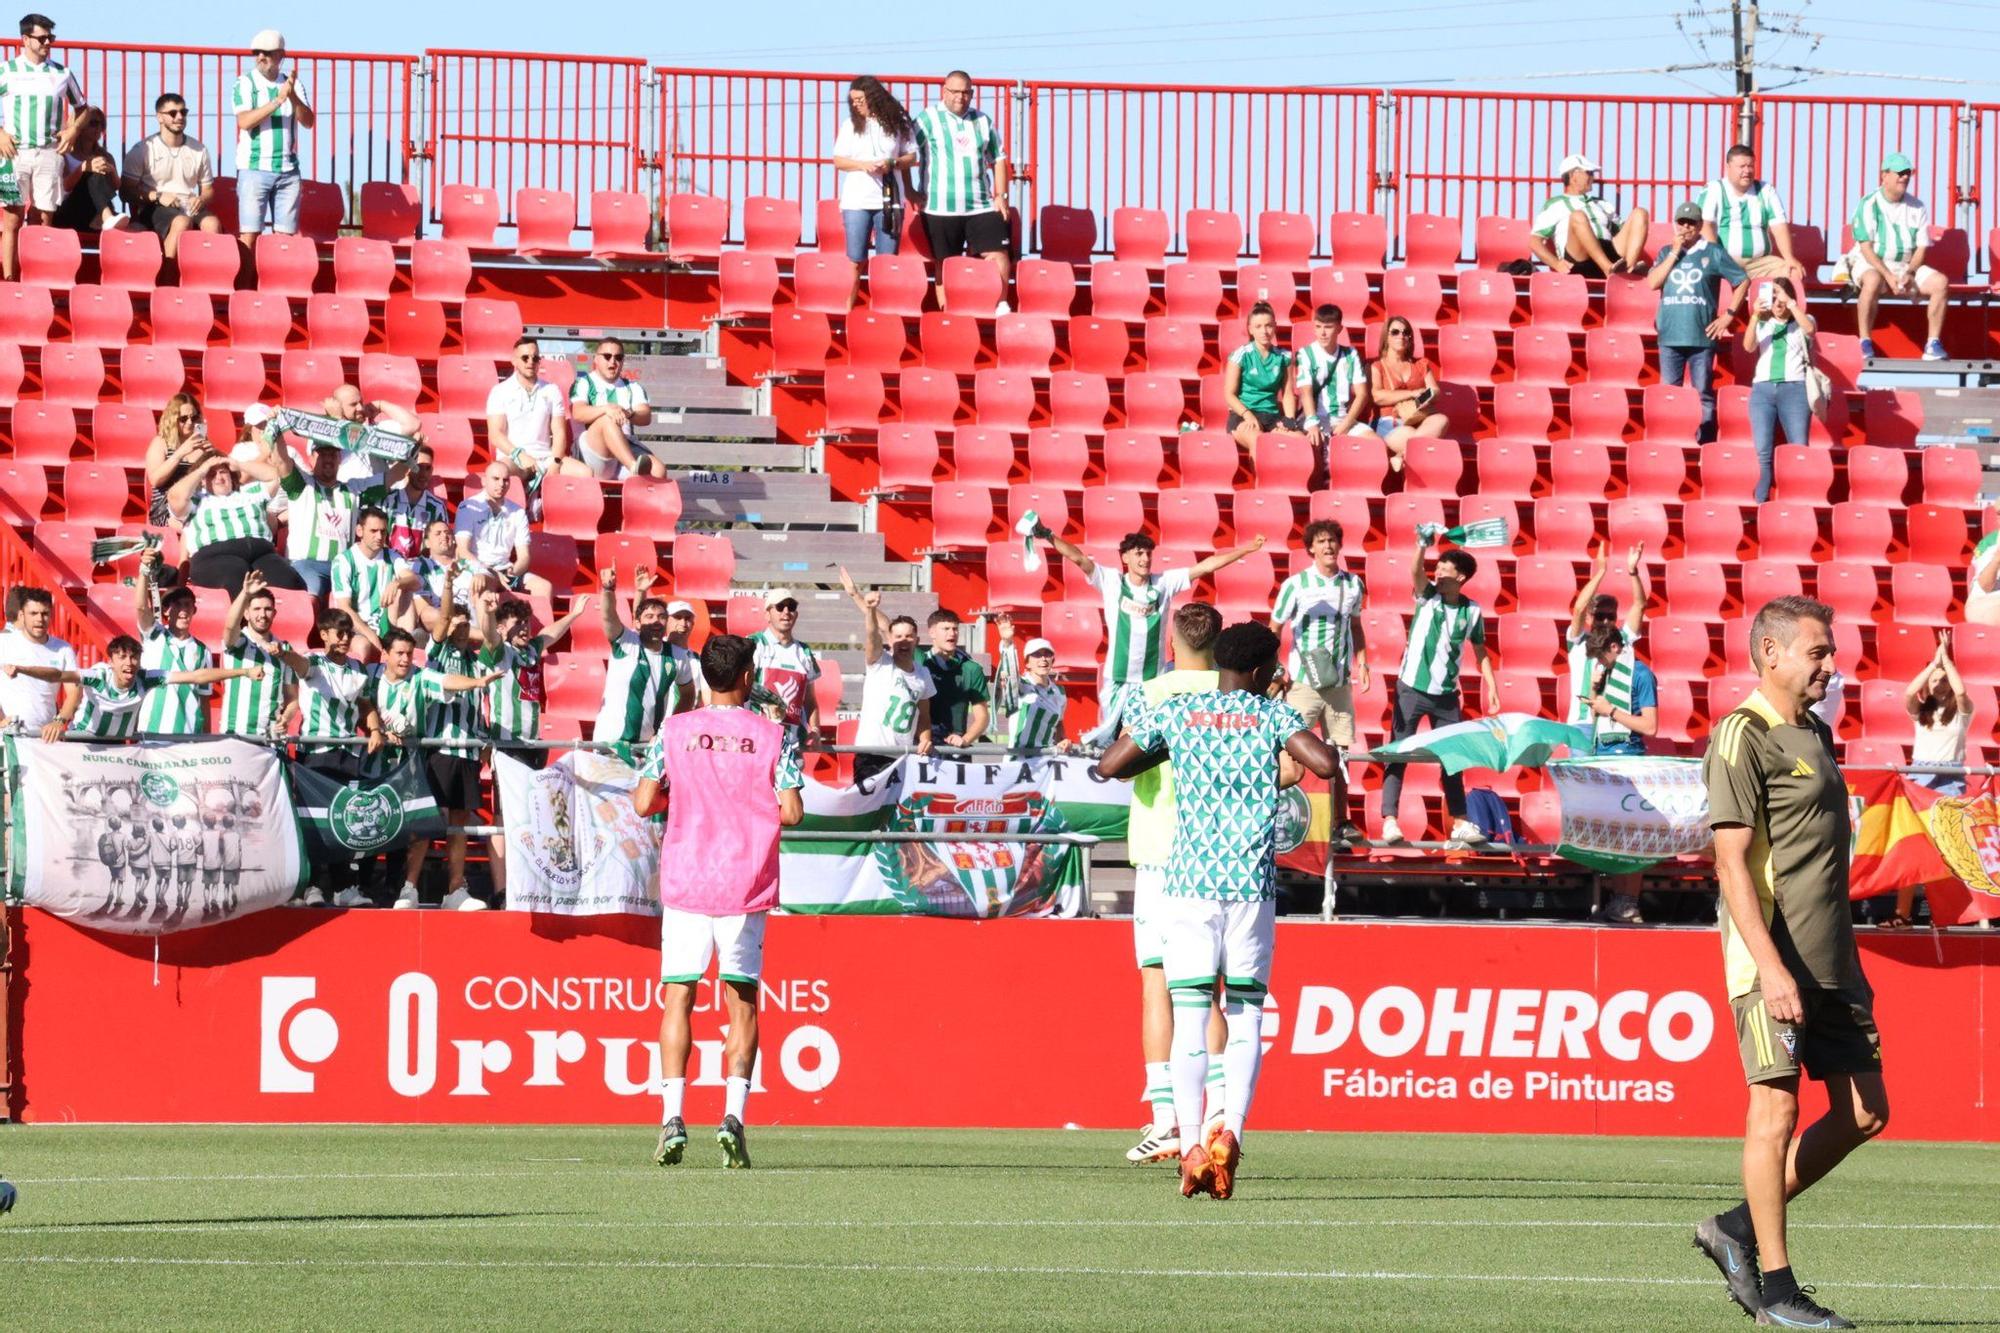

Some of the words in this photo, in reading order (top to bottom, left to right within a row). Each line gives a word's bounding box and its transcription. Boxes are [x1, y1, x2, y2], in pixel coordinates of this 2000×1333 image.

[1663, 295, 1707, 306] SILBON
[692, 472, 719, 484] FILA
[722, 473, 730, 484] 8
[882, 694, 917, 734] 18
[82, 753, 124, 764] NUNCA
[201, 755, 232, 766] SOLO
[1291, 985, 1715, 1062] DOHERCO
[1322, 1067, 1462, 1100] Fábrica
[1469, 1069, 1513, 1099] de
[1525, 1070, 1675, 1103] Pinturas
